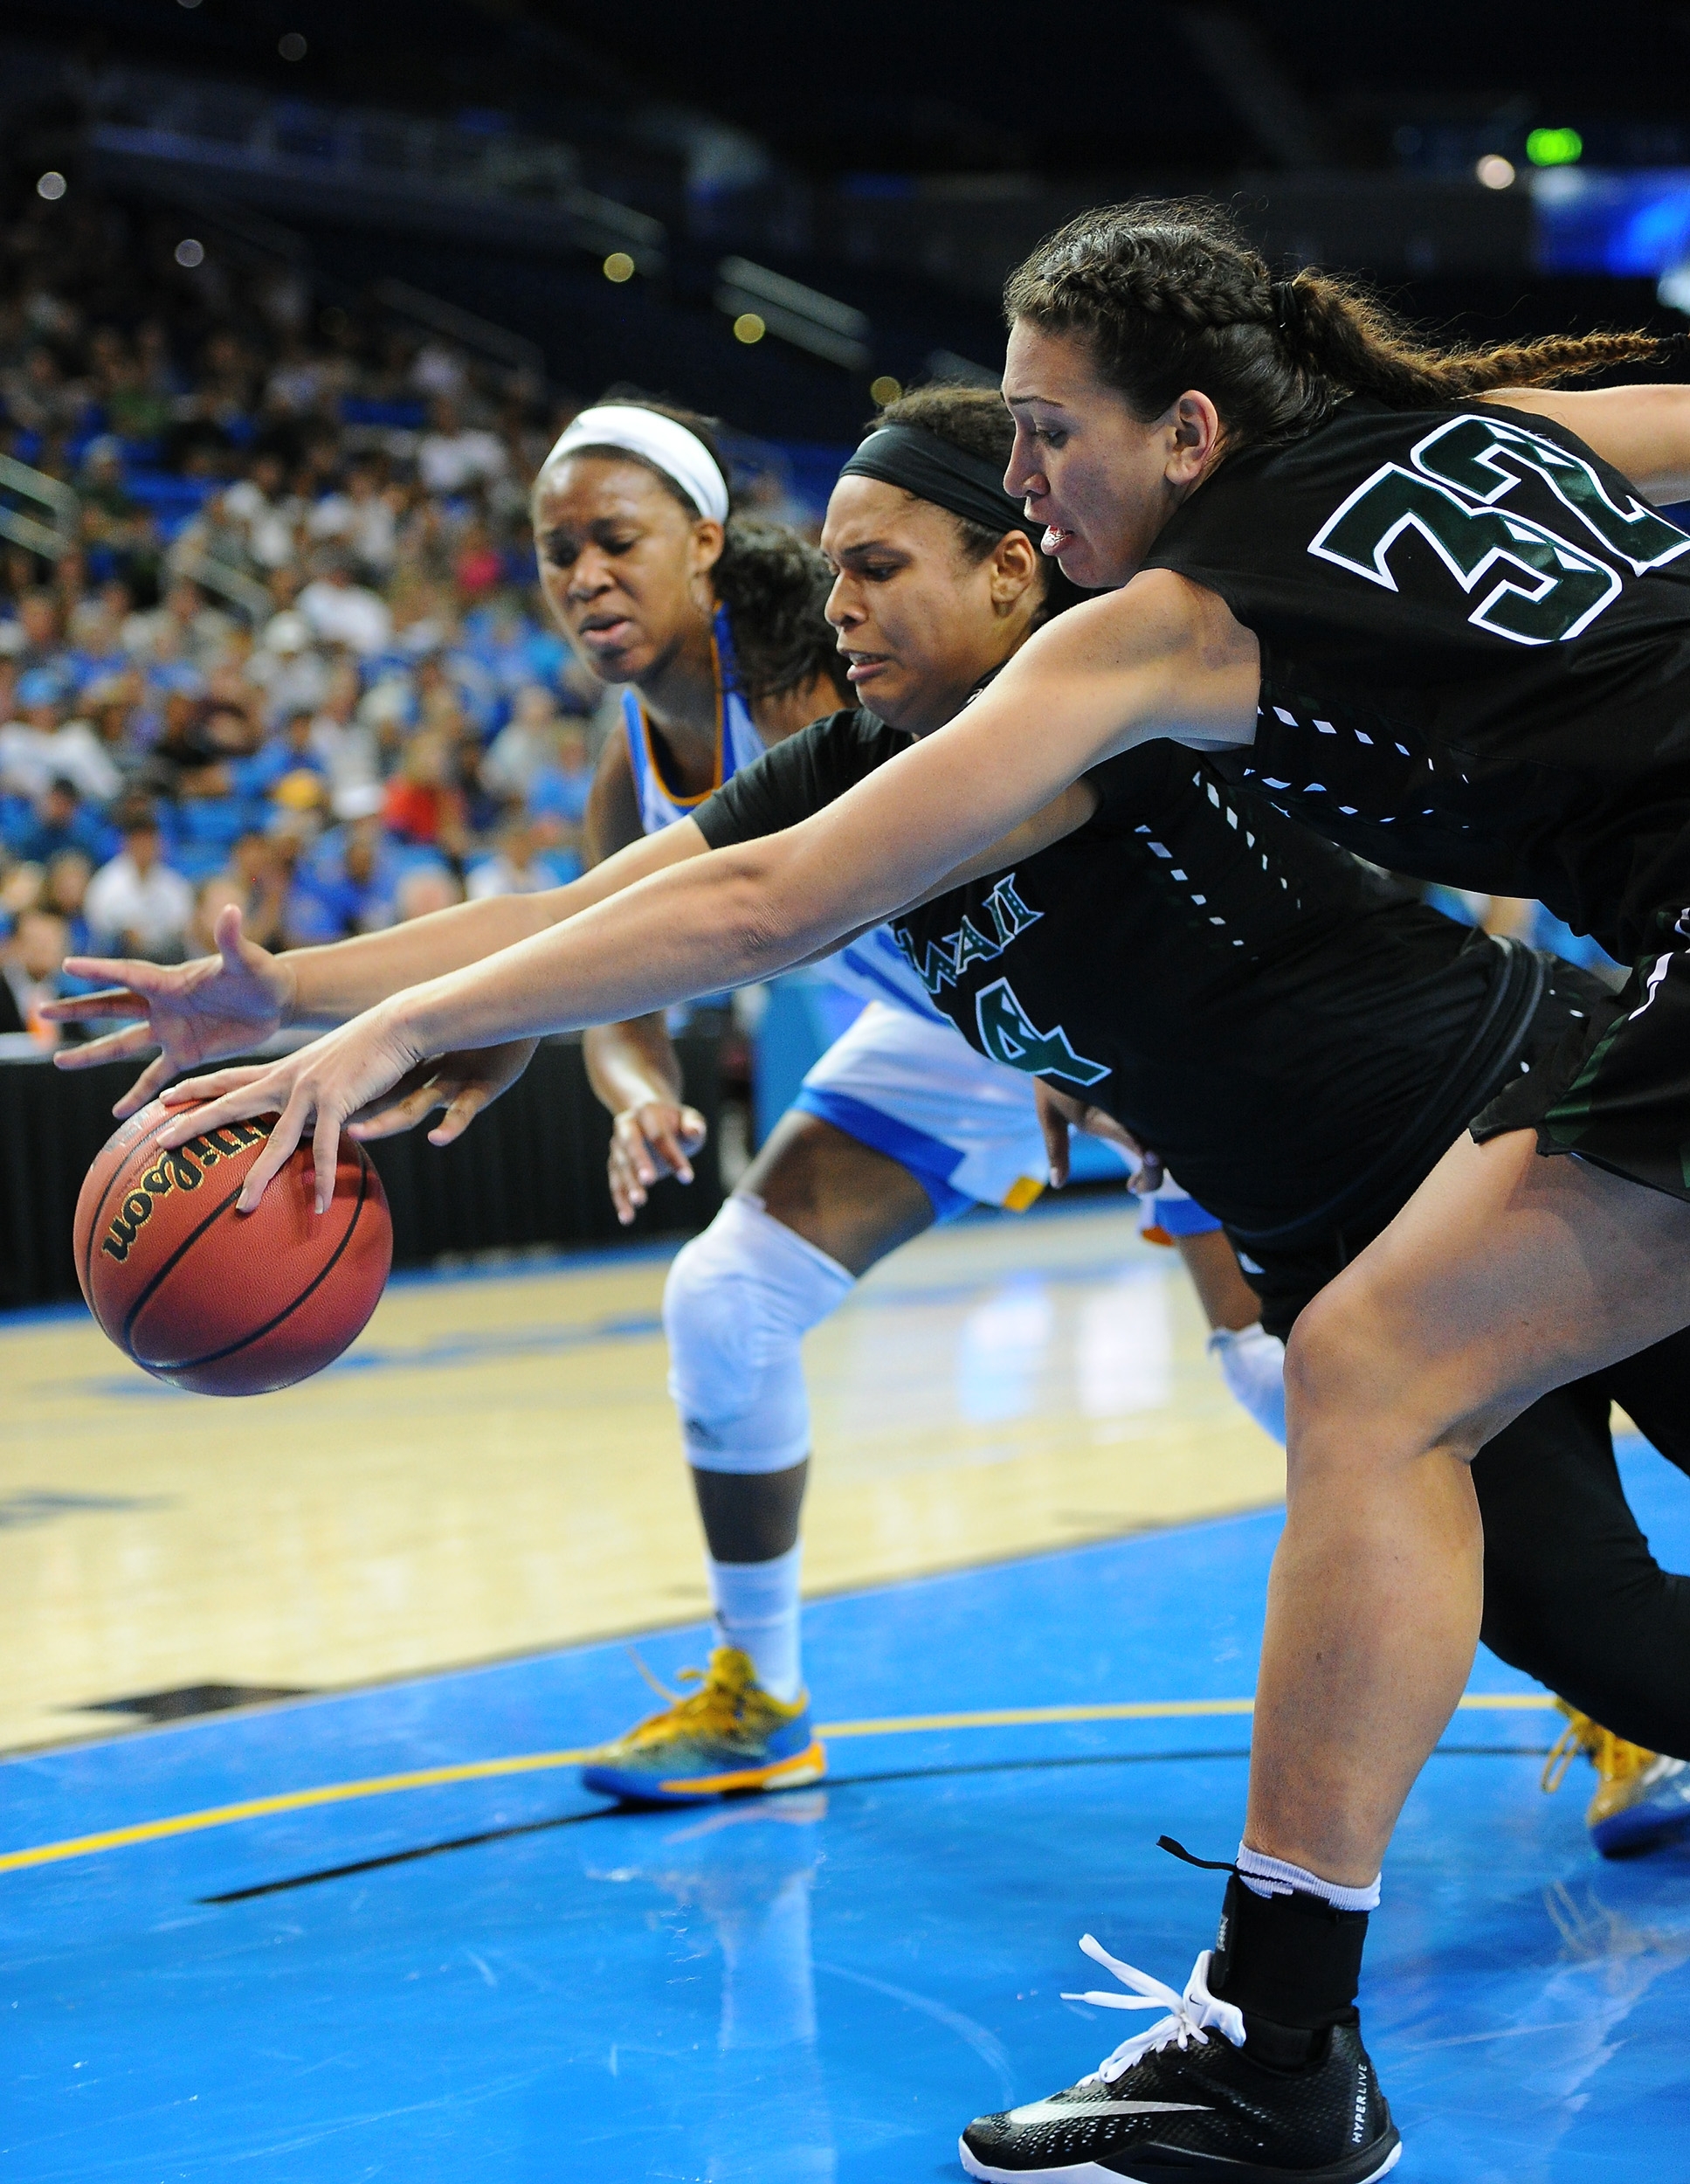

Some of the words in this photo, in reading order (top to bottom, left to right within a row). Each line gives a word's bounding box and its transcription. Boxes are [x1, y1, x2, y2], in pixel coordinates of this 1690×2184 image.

[1307, 413, 1690, 646] 32
[891, 872, 1045, 994] WAII
[938, 976, 1113, 1087] 4
[1351, 2063, 1368, 2143] HYPERLIVE
